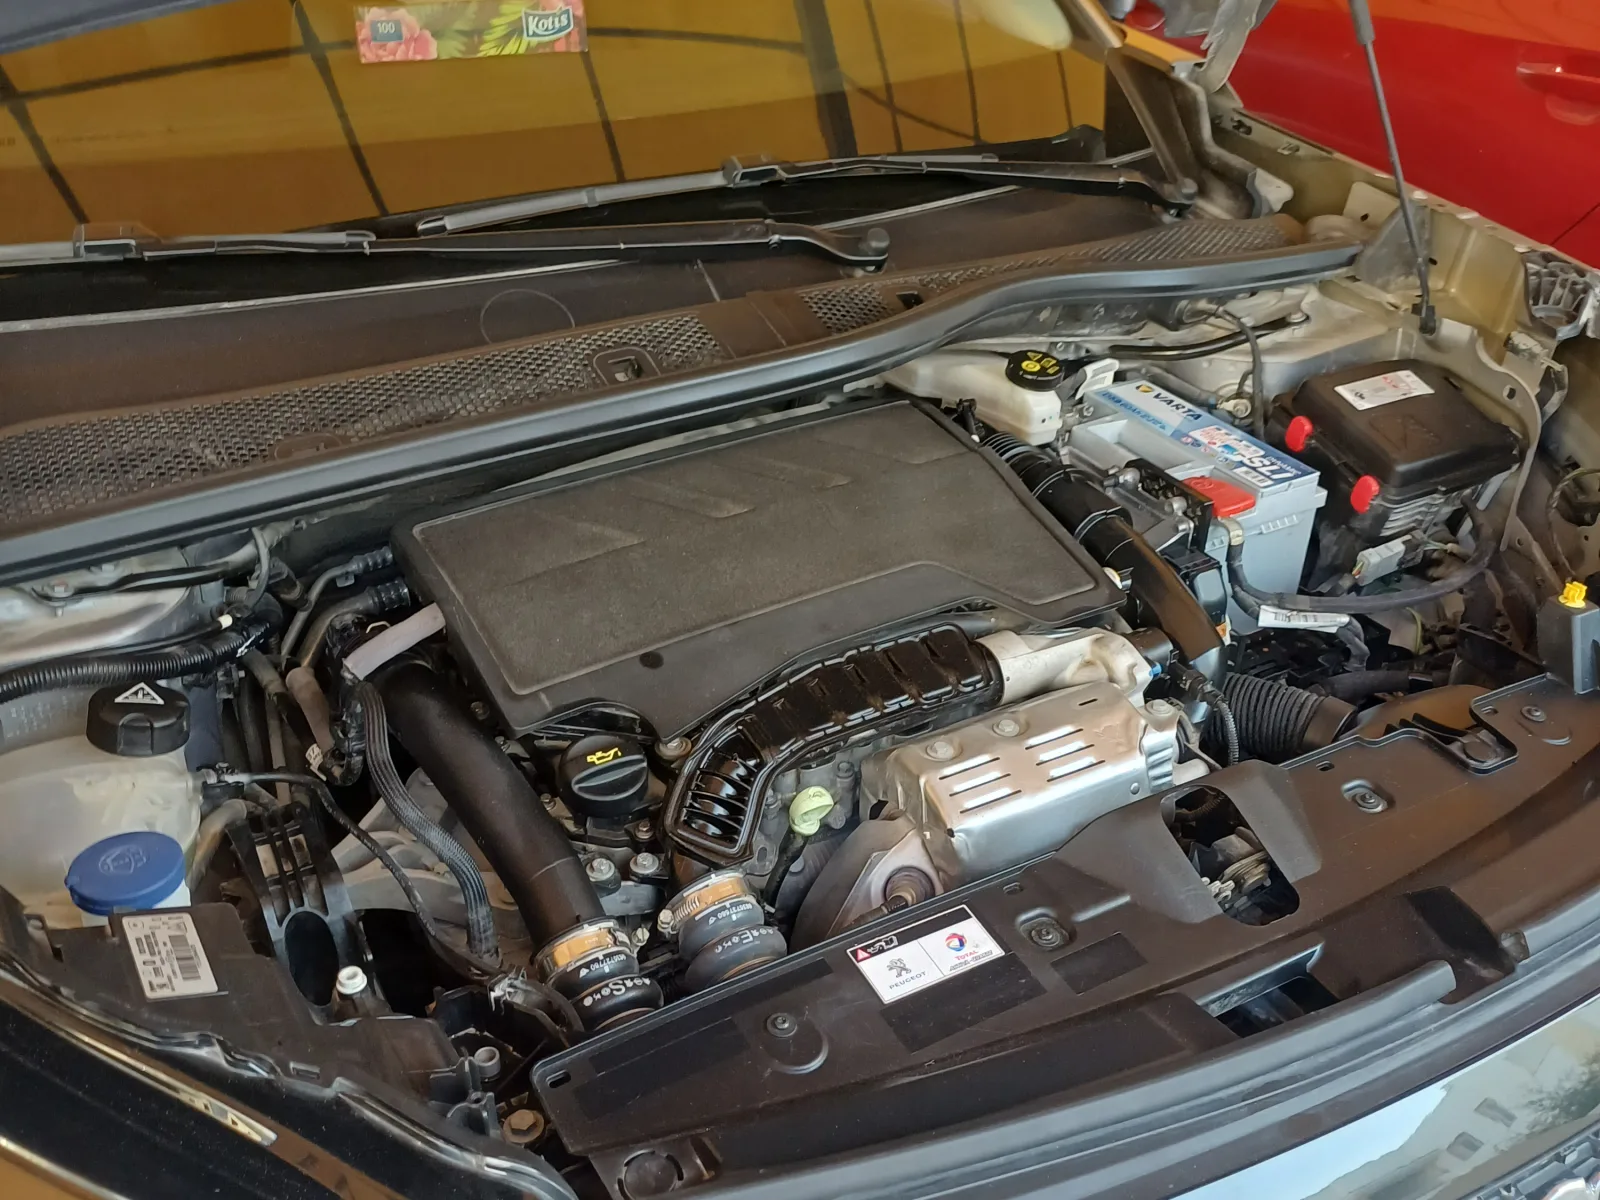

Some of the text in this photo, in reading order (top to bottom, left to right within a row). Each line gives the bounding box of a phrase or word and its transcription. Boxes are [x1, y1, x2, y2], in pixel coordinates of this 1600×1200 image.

[377, 21, 396, 34] 100
[1153, 392, 1203, 421] VARTA
[954, 949, 978, 961] TOTAL
[888, 970, 927, 990] PEUGEOT
